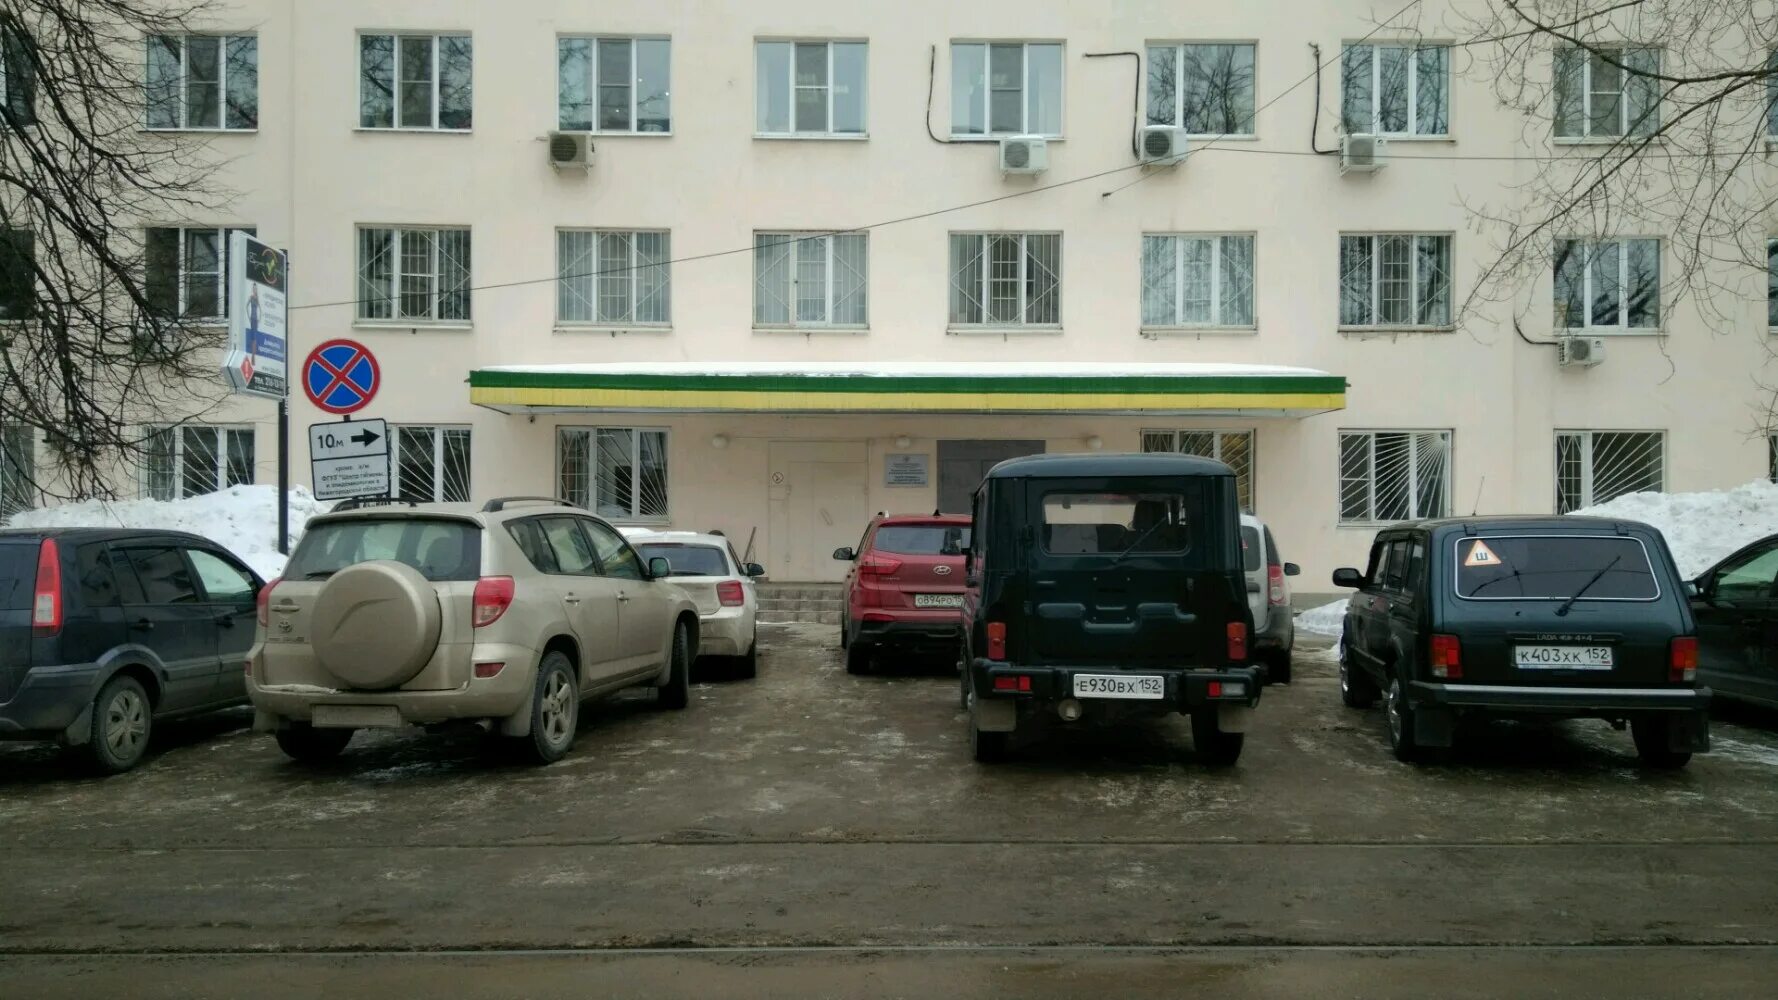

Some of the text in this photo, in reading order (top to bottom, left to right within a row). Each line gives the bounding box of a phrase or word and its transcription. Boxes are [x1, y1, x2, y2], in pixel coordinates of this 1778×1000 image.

[1475, 552, 1488, 561] Ш
[1536, 633, 1558, 641] LADA
[1584, 648, 1608, 660] 152
[1138, 678, 1159, 690] 152
